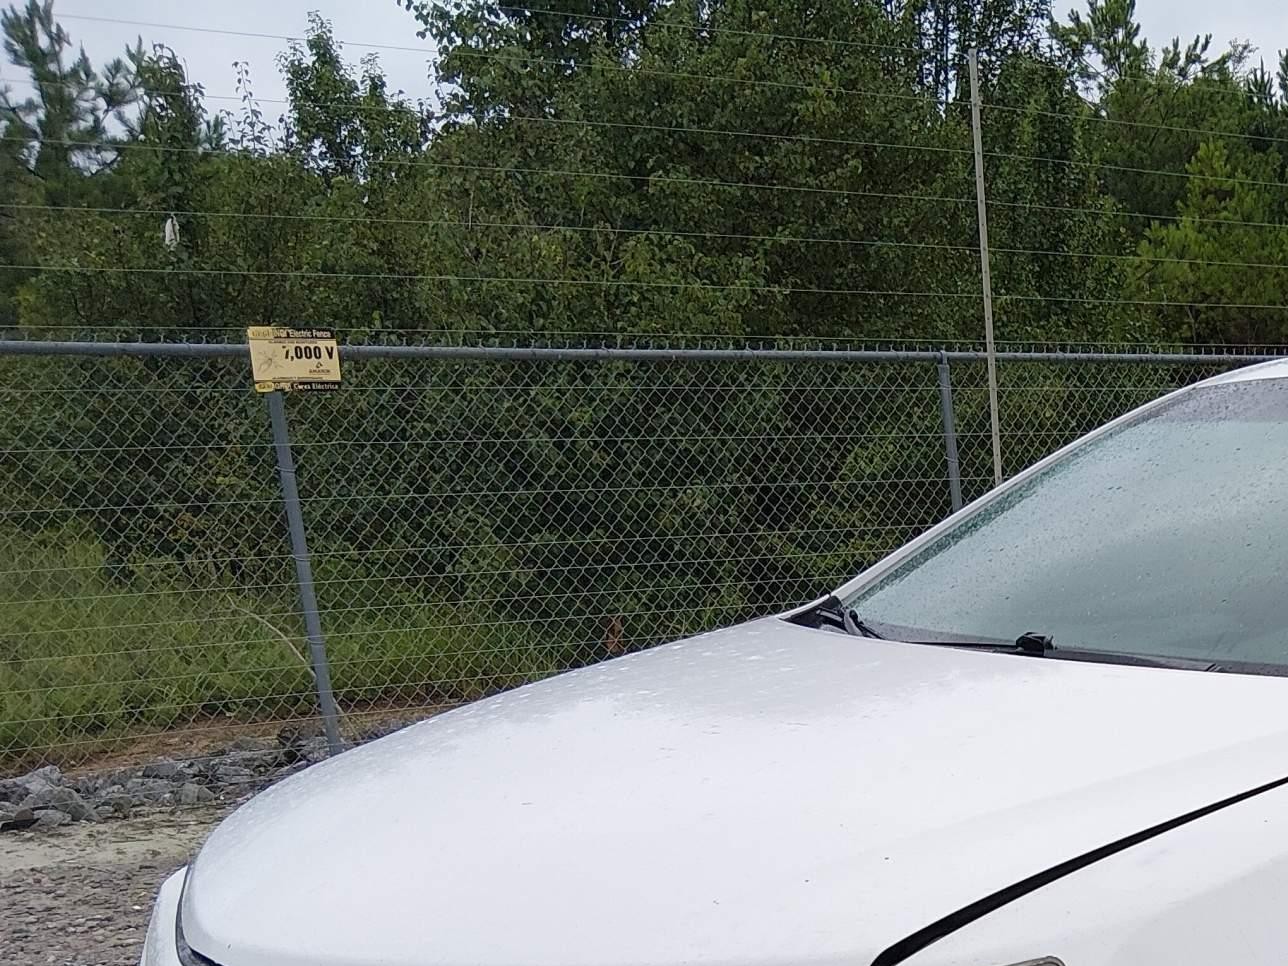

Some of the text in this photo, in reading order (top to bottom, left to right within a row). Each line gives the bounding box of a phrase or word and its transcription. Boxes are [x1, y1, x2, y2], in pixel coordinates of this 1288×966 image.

[289, 330, 312, 338] Electric
[282, 346, 334, 361] 7,000 V
